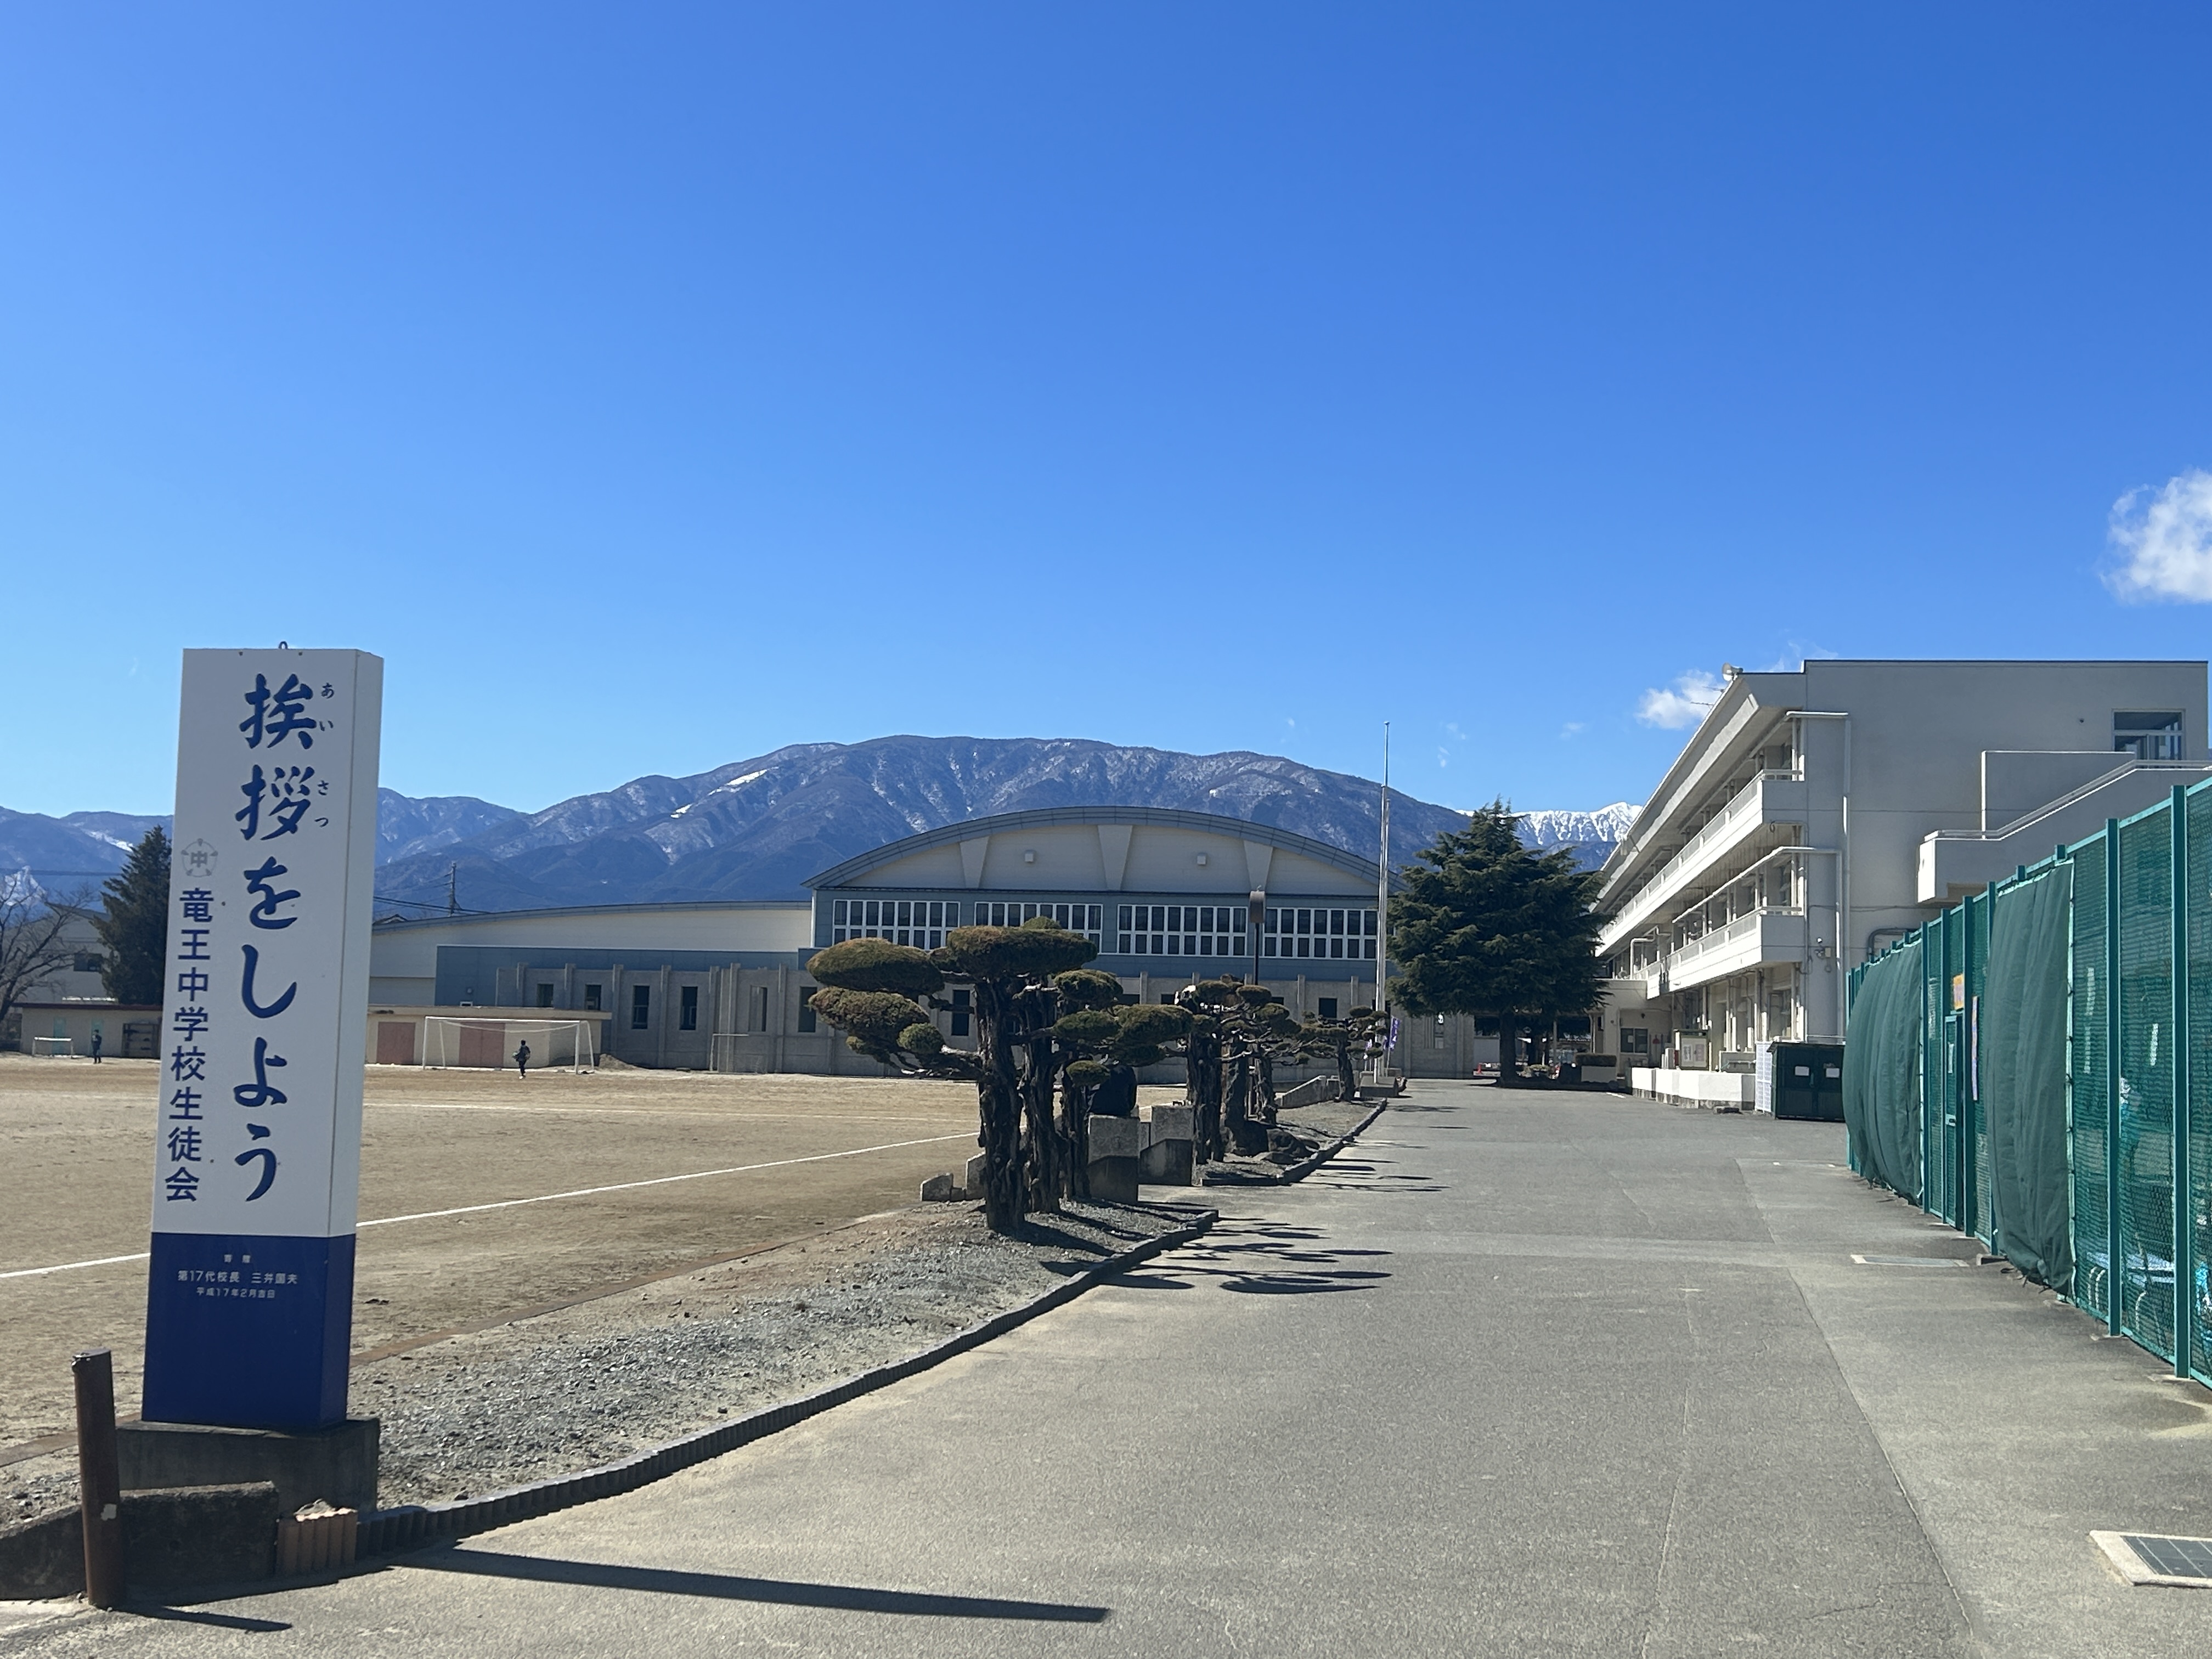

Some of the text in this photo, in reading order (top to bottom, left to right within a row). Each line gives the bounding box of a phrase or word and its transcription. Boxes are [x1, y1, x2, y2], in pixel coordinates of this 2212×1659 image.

[165, 887, 215, 1203] 竜王中学校生徒会
[233, 673, 317, 1202] 挨拶をしよう
